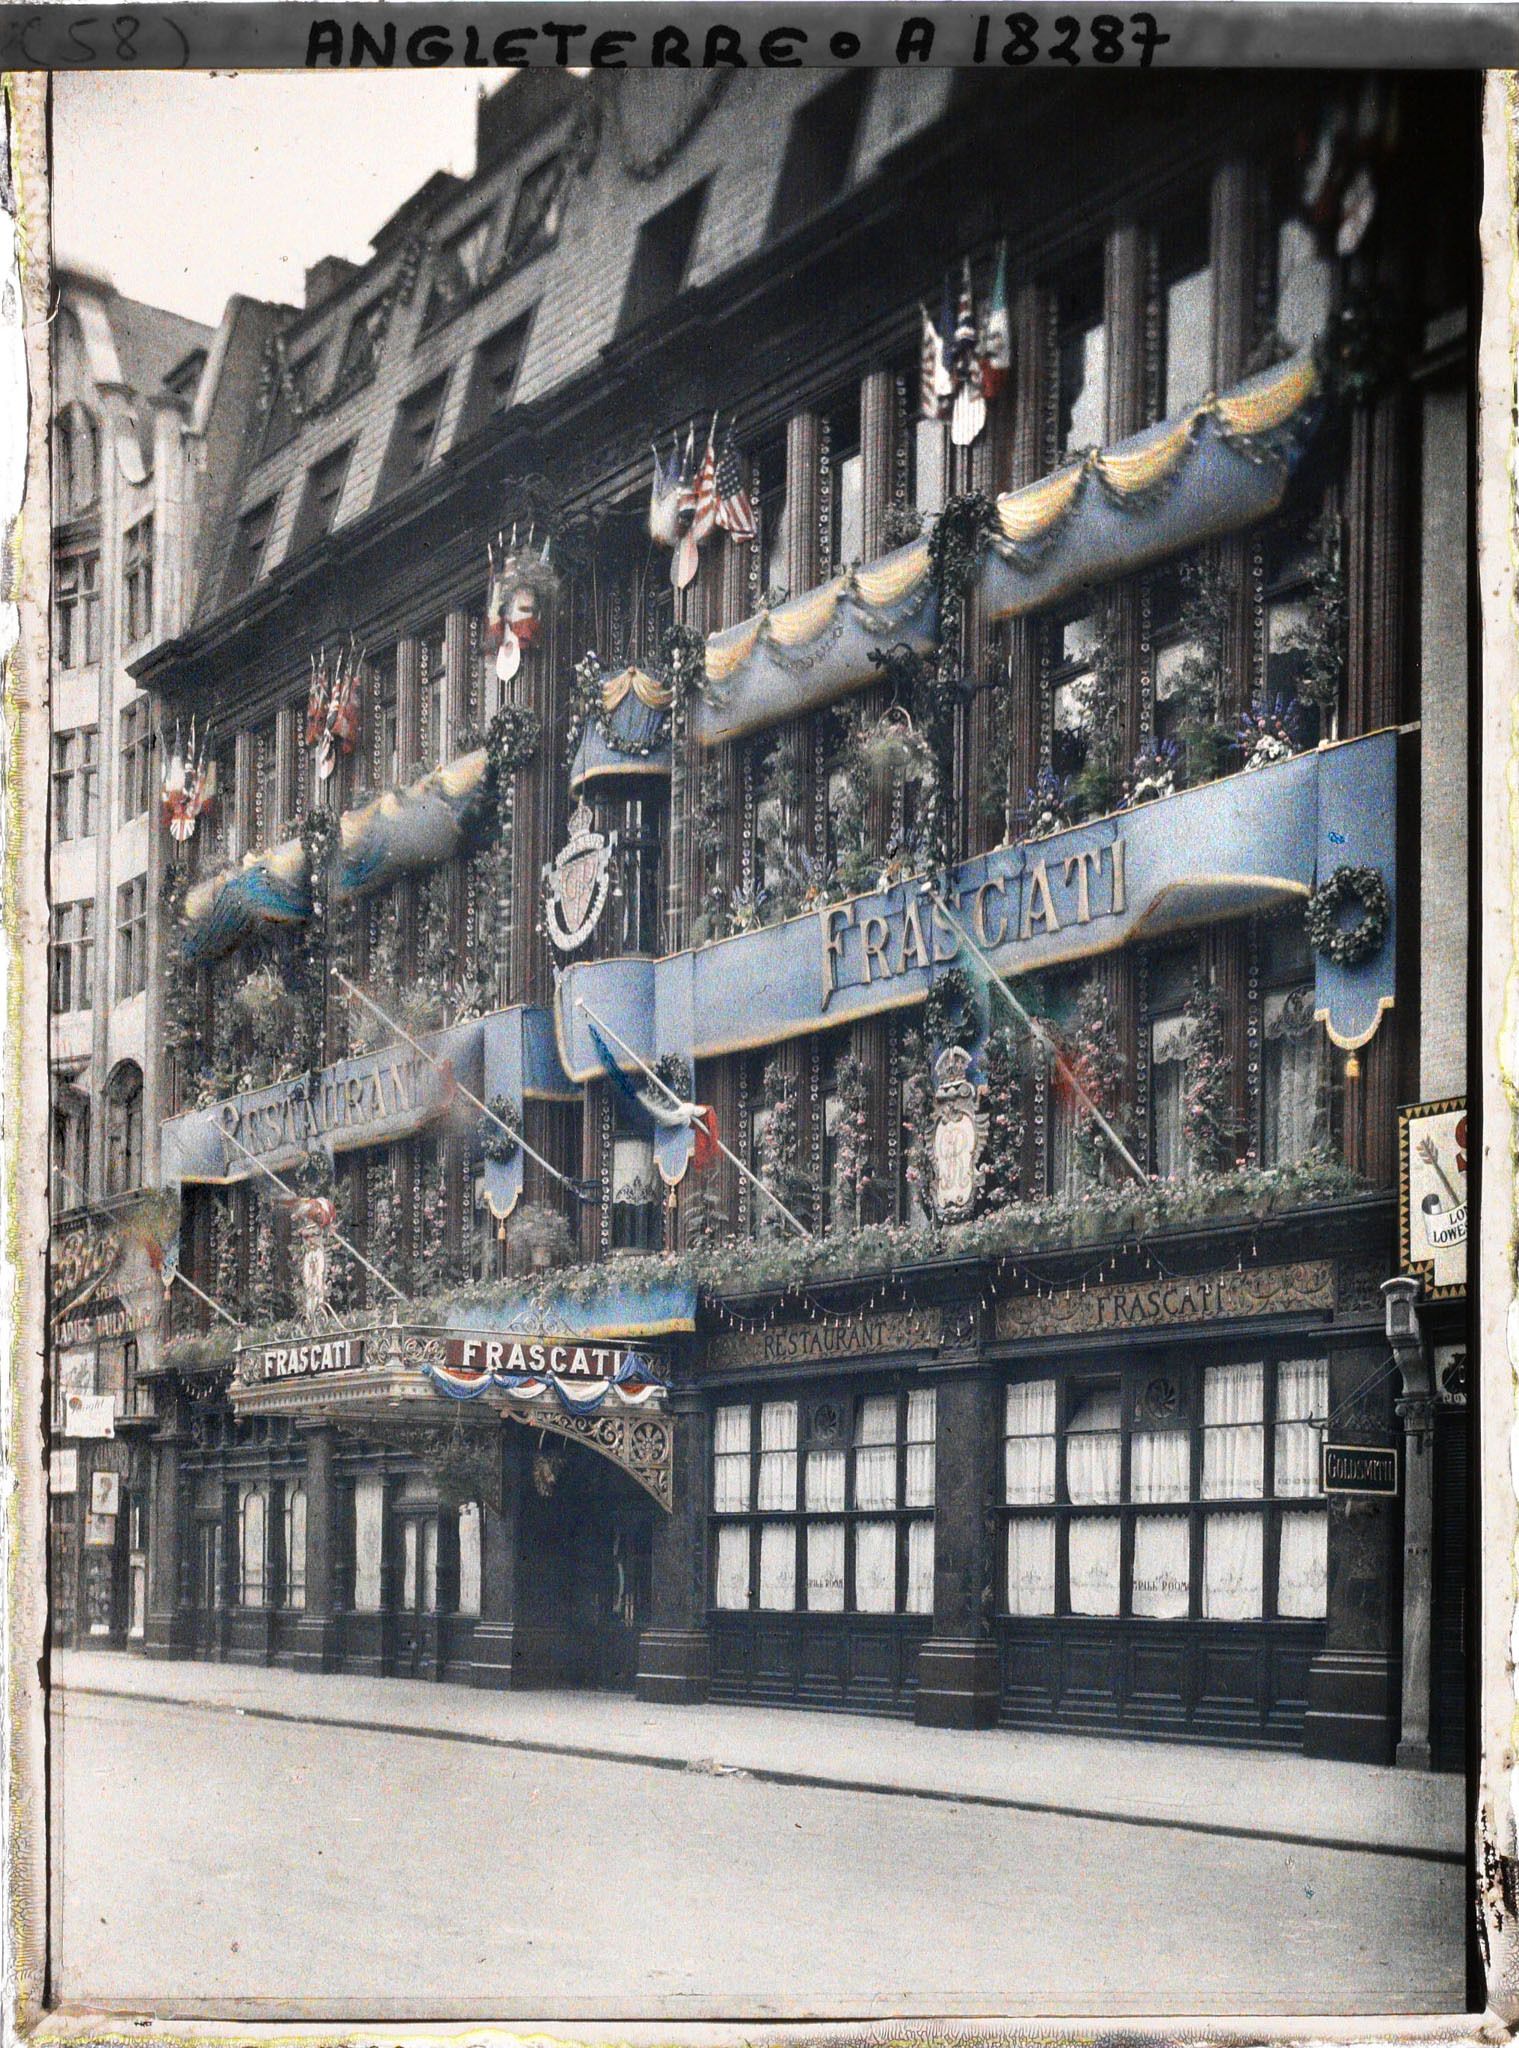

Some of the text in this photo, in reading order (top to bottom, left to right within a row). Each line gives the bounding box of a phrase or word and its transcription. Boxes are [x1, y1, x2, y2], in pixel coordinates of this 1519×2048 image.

[305, 19, 808, 68] ANGLETERRE
[896, 17, 936, 64] A
[972, 12, 1171, 67] 18287
[819, 839, 1127, 1012] FRASCATI
[1433, 1223, 1468, 1244] LOWE
[1449, 1205, 1468, 1226] LO
[1096, 1281, 1227, 1323] FRASCATI
[764, 1320, 887, 1359] RESTAURANT
[264, 1340, 352, 1377] FRASCATI
[463, 1340, 623, 1377] FRASCATI
[1328, 1453, 1393, 1481] GOLDSMITH
